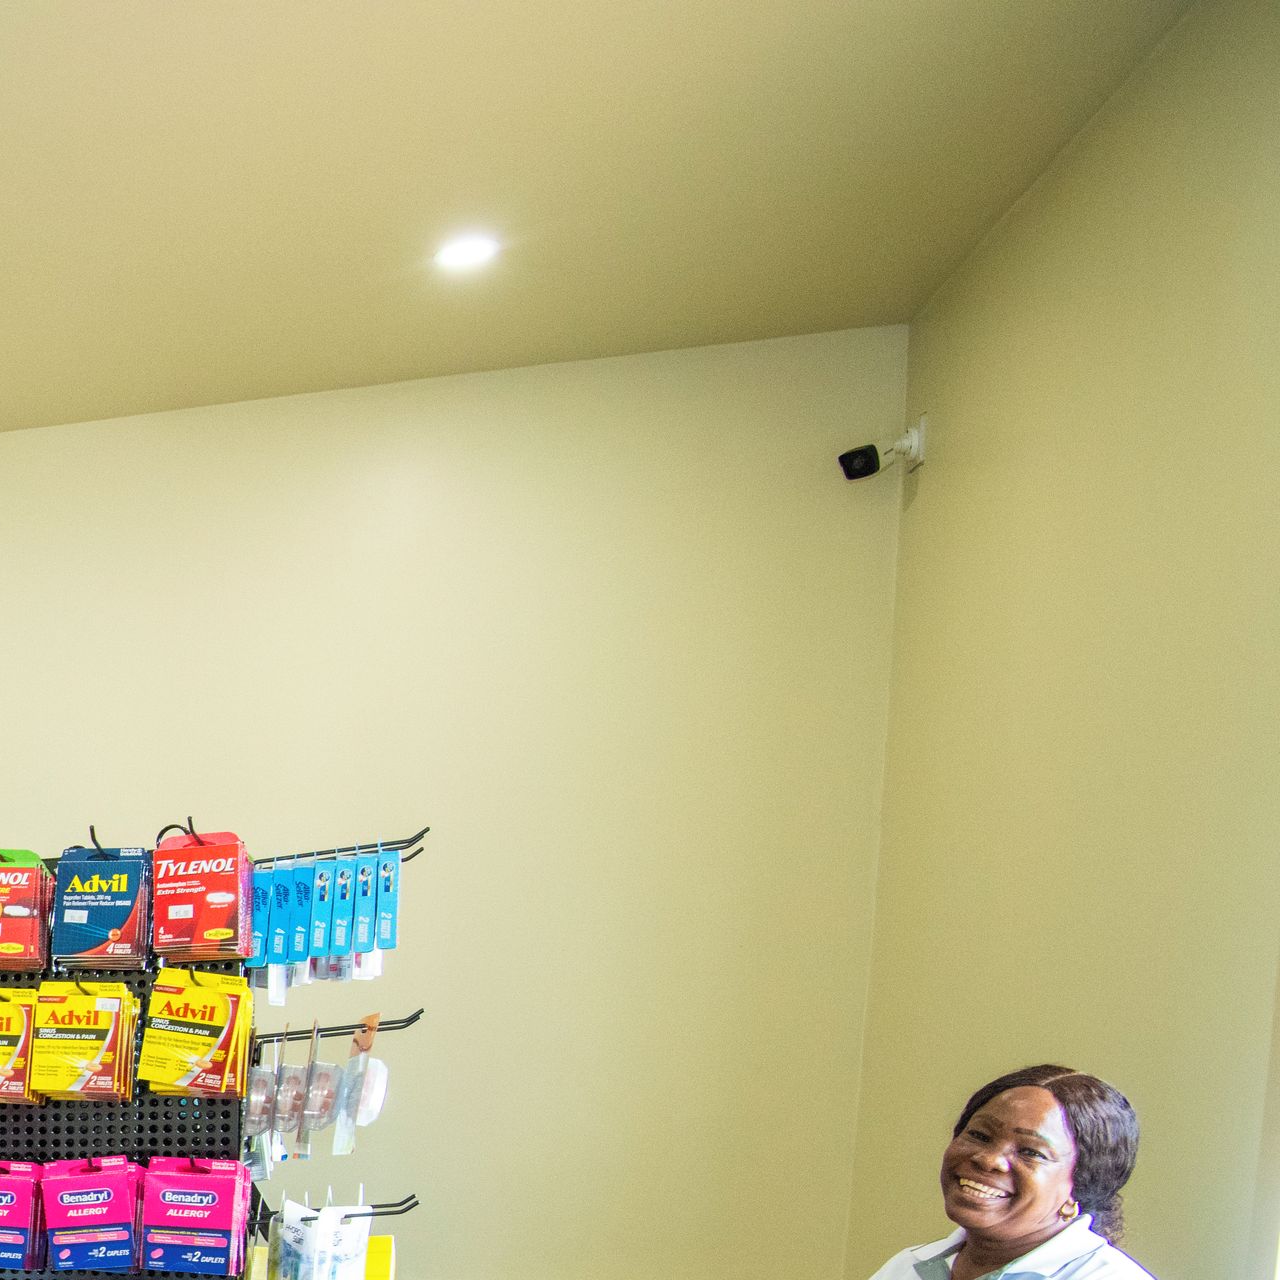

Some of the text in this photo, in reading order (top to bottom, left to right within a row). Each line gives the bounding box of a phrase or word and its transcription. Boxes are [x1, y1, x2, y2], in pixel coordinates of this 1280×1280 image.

[156, 858, 236, 879] TYLENOL
[65, 873, 128, 893] Advil
[176, 886, 206, 894] Strength
[105, 942, 113, 954] 4
[158, 1000, 217, 1022] Advil
[44, 1010, 99, 1026] Advil
[151, 1023, 188, 1033] CONGESTION
[89, 1076, 97, 1085] 2
[197, 1073, 205, 1082] 2
[1, 1081, 9, 1090] 2
[62, 1191, 108, 1204] Benadryl
[164, 1192, 214, 1205] Benadryl
[67, 1207, 108, 1217] ALLERGY
[166, 1208, 212, 1218] ALLERGY
[99, 1246, 106, 1256] 2
